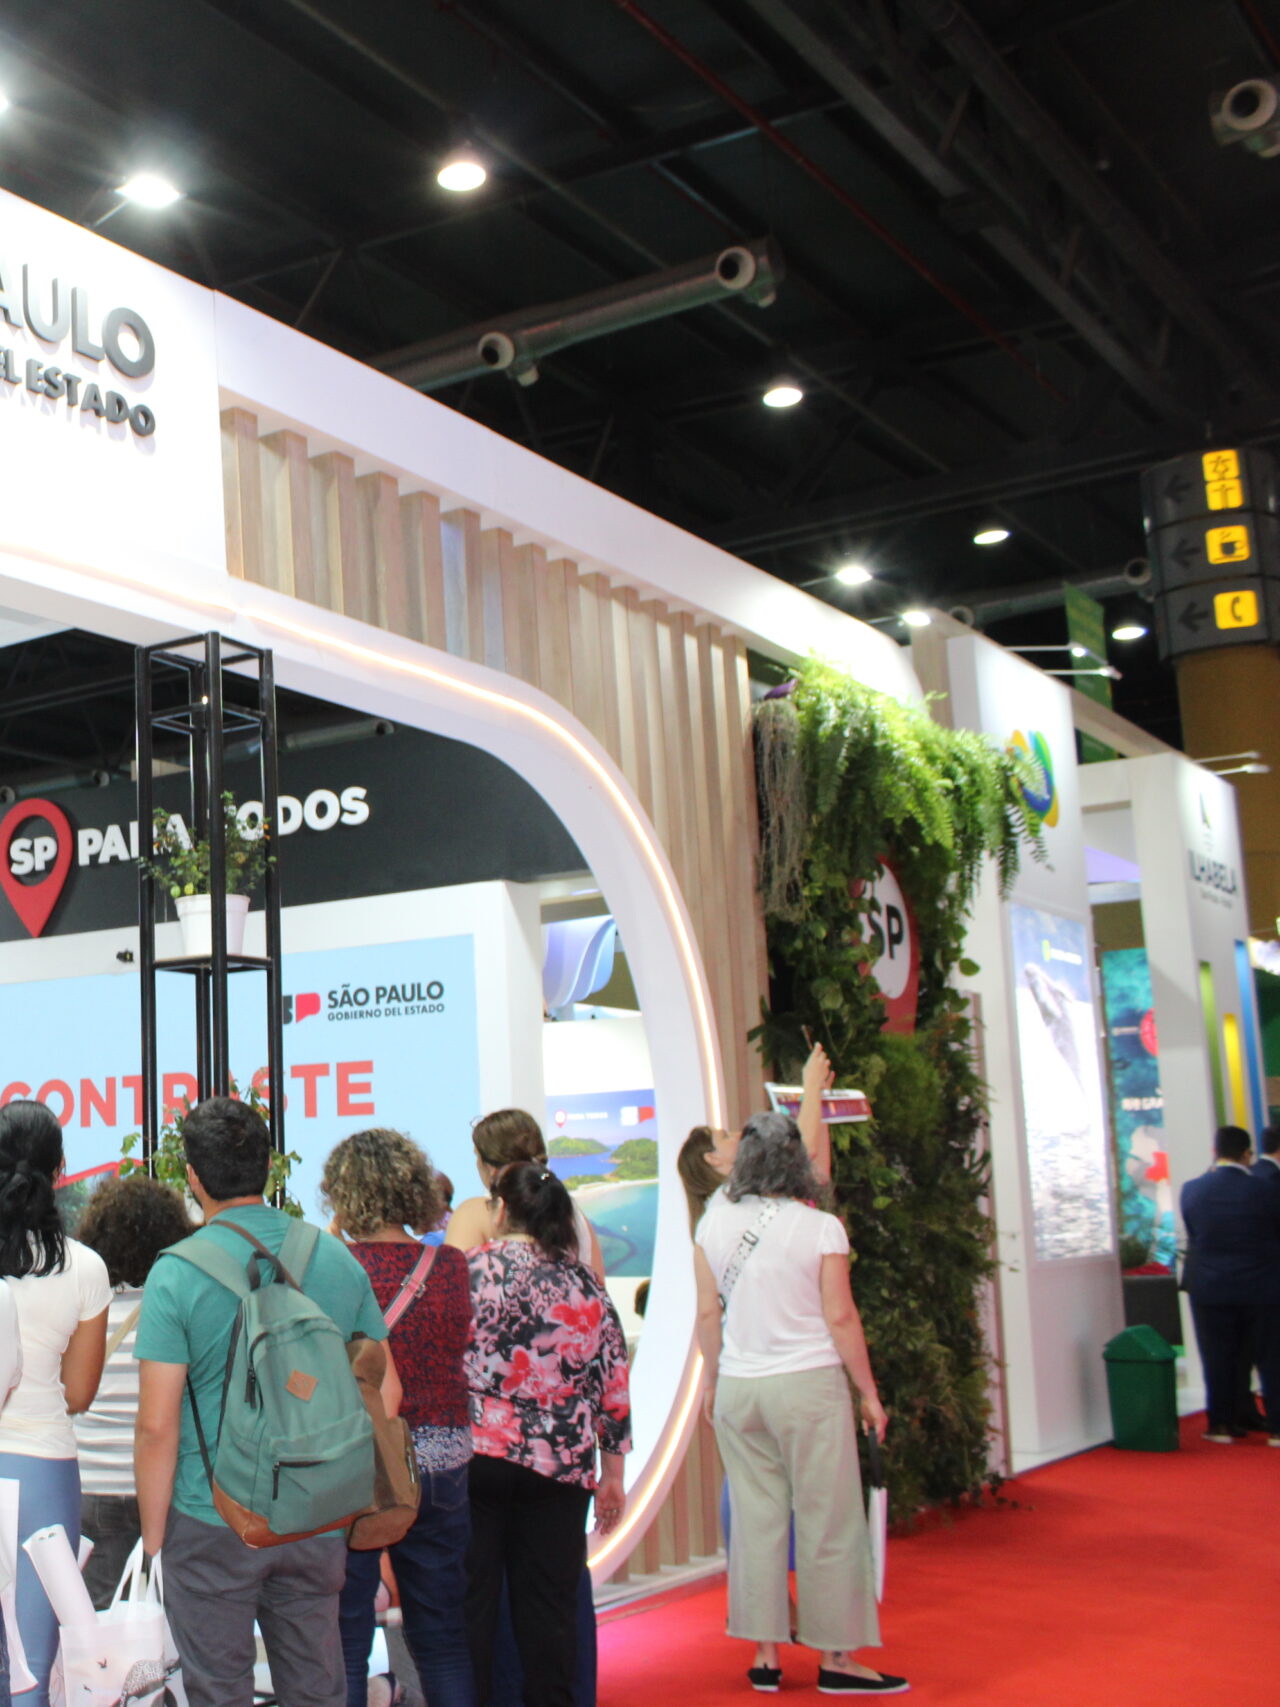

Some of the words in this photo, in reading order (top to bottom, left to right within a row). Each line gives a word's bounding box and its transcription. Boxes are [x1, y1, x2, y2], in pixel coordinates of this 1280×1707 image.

[25, 358, 156, 437] ESTADO
[9, 835, 58, 876] SP
[207, 786, 371, 841] ODOS
[327, 983, 370, 1009] SÃO
[375, 980, 445, 1005] PAULO
[327, 1009, 382, 1022] GOBIERNO
[384, 1006, 402, 1017] DEL
[404, 1003, 445, 1016] ESTADO
